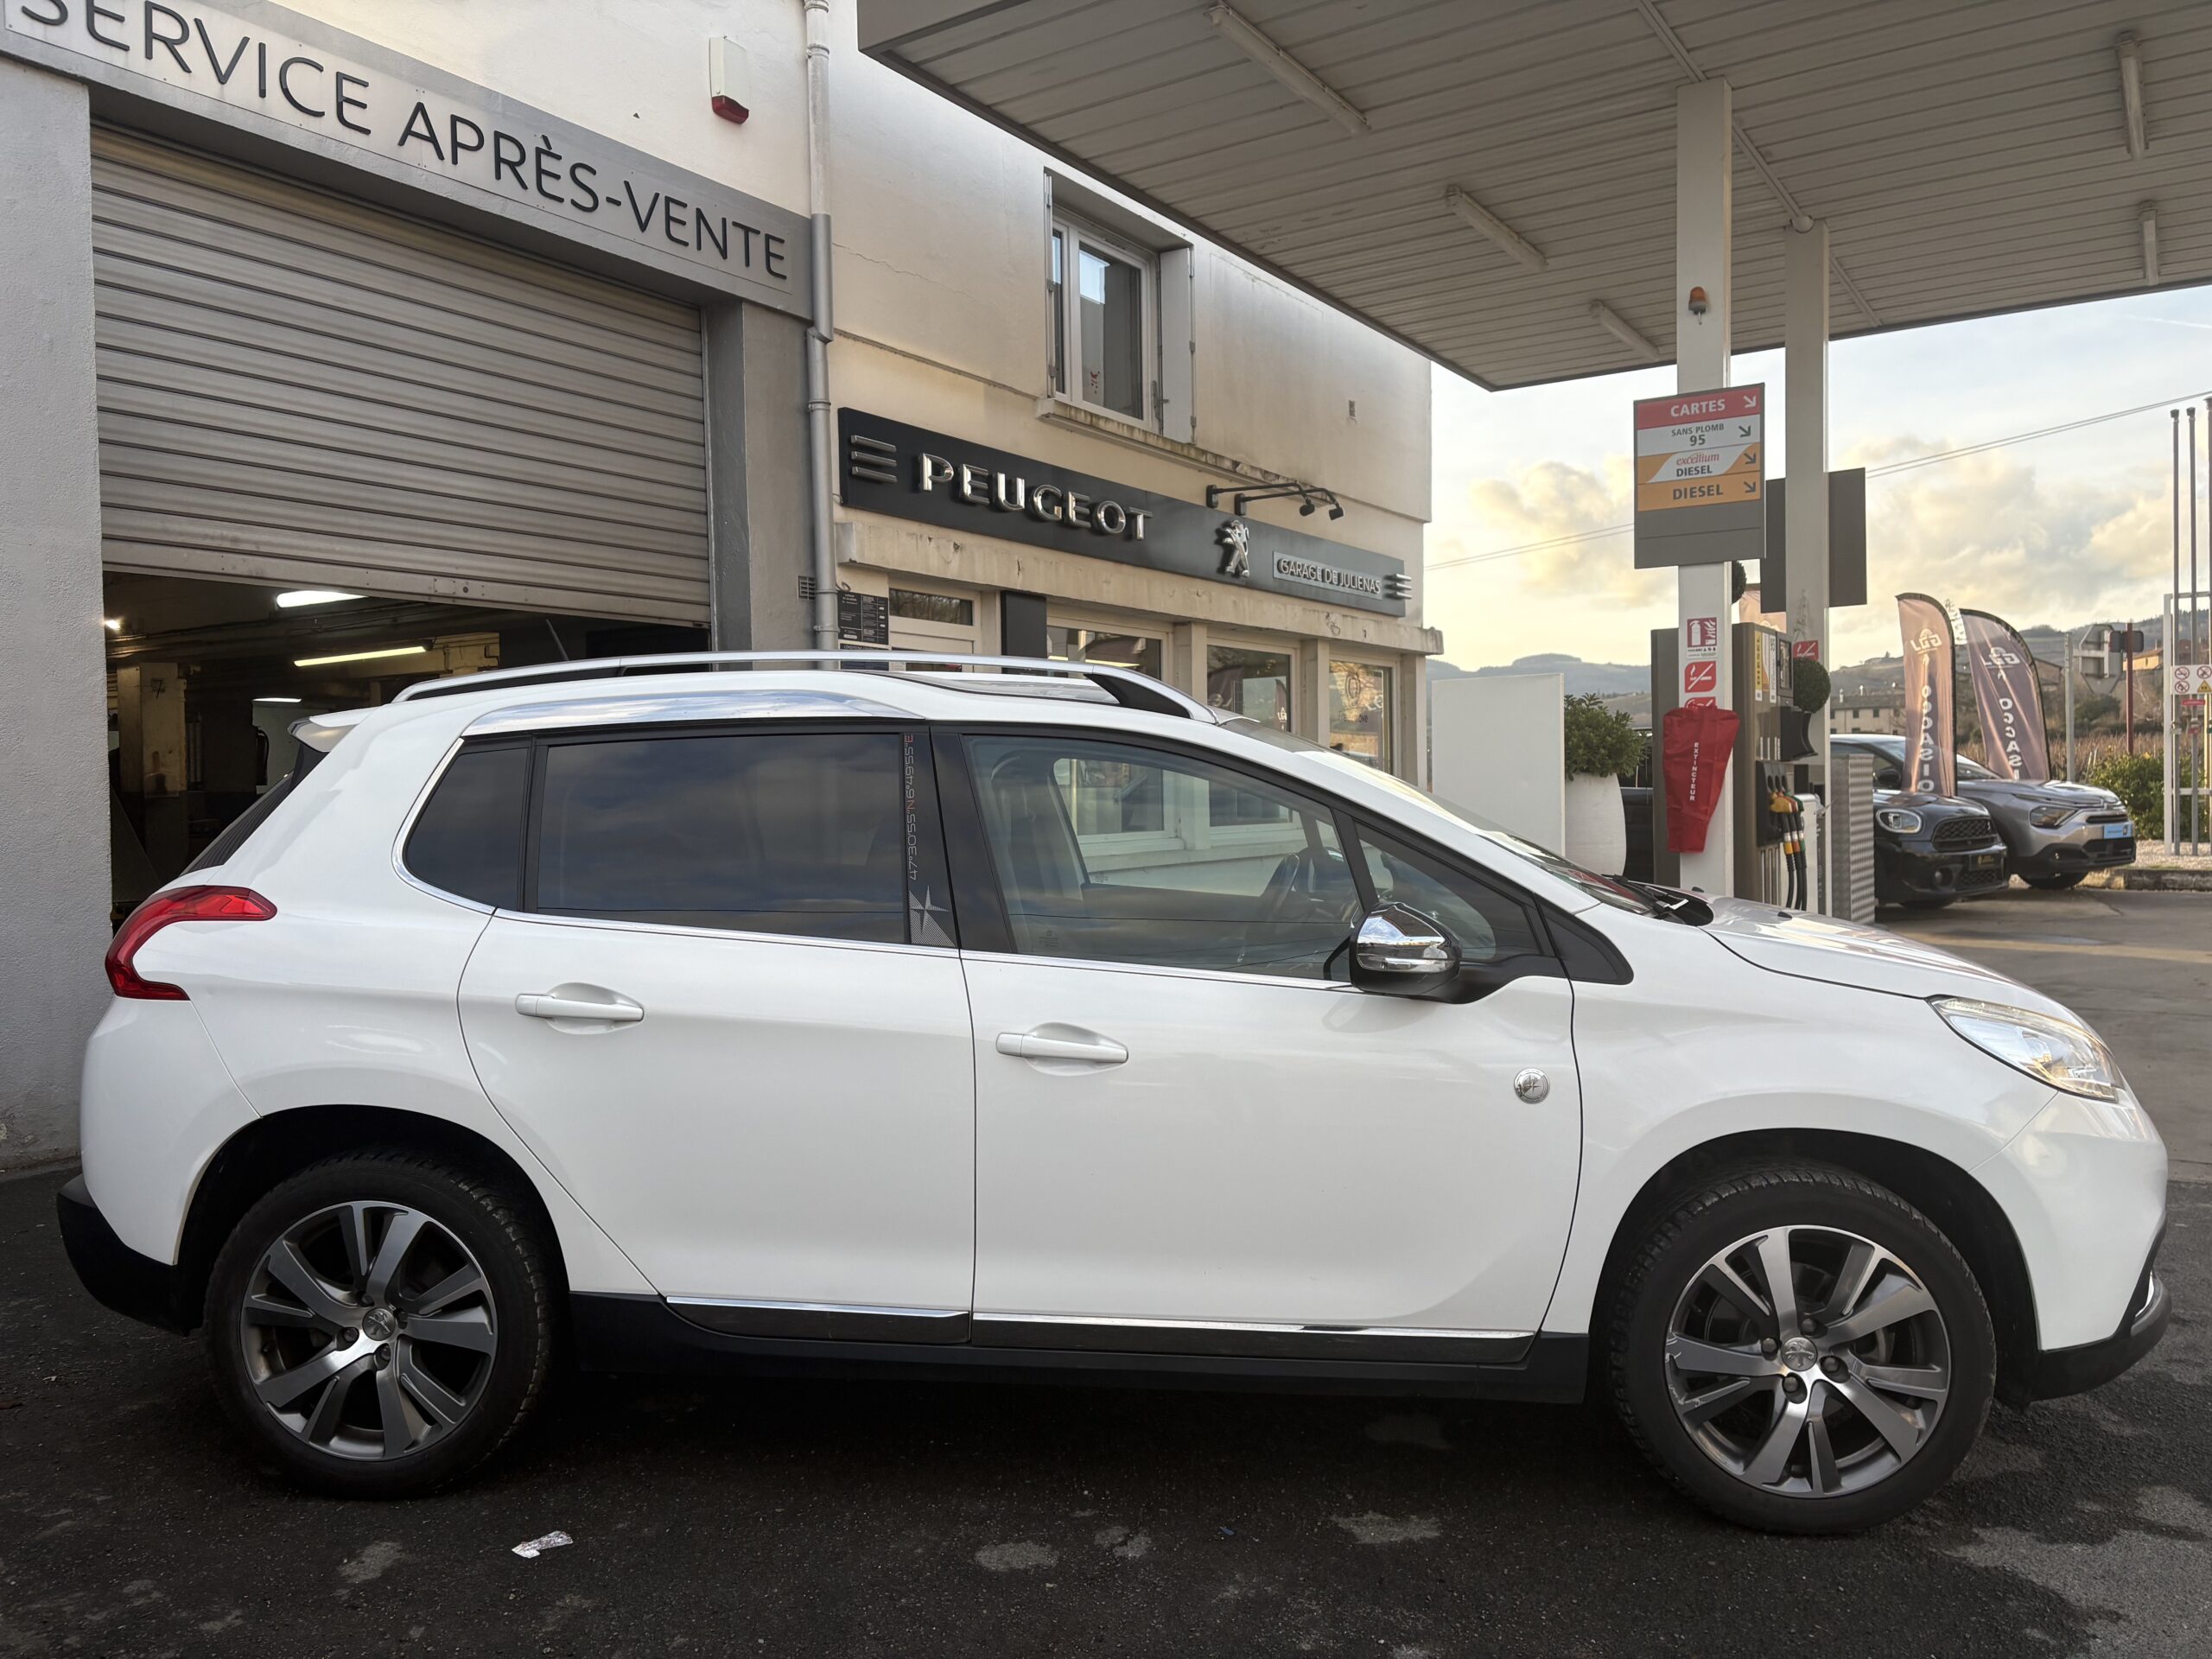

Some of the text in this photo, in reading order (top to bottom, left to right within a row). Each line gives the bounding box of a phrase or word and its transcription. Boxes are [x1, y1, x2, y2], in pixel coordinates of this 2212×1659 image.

[397, 101, 787, 280] APRÈS-VENTE
[1670, 398, 1726, 417] CARTES
[1671, 423, 1725, 436] SANS PLOMB
[1689, 434, 1706, 447] 95
[1675, 452, 1719, 467] excellium
[1675, 465, 1713, 478] DIESEL
[921, 453, 1154, 540] PEUGEOT
[1672, 484, 1724, 500] DIESEL
[1279, 557, 1382, 594] GARAGE DE JULIENAS
[1689, 742, 1700, 802] EXTINCTEUR
